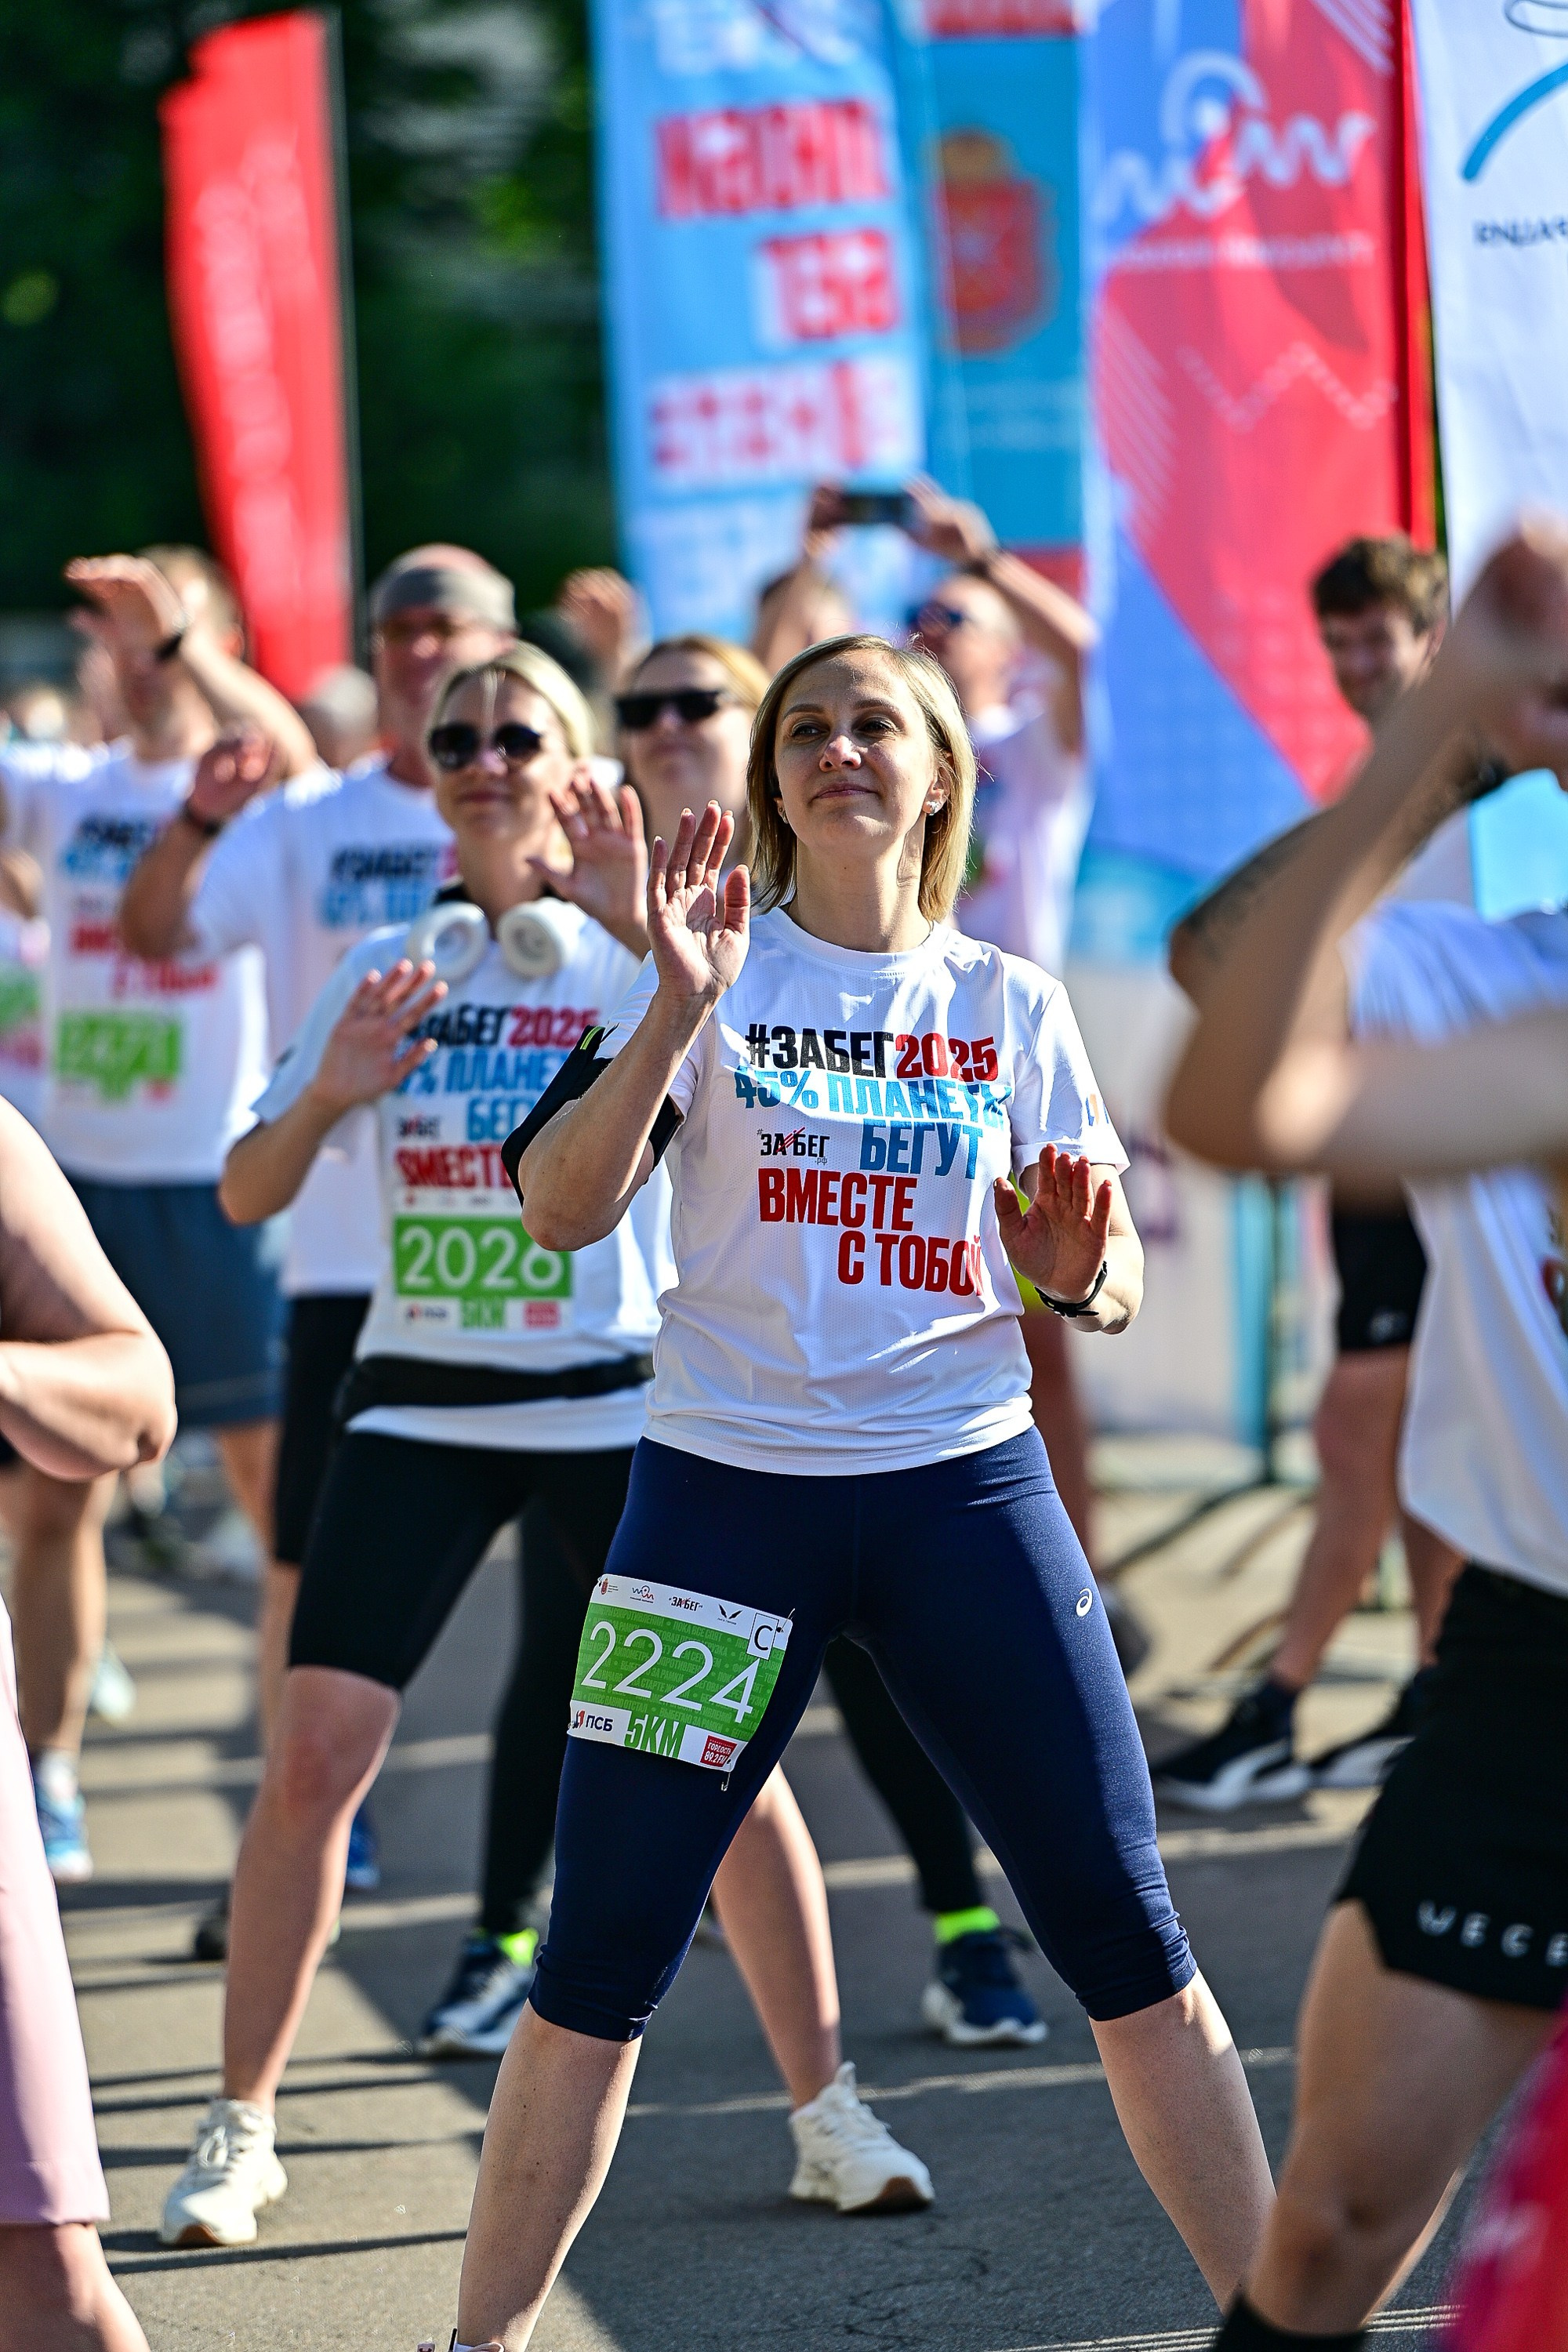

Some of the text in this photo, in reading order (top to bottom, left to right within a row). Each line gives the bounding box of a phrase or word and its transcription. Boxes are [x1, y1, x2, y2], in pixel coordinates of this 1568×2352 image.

[735, 1065, 817, 1109] 45%
[859, 1119, 983, 1180] БЕГУТ
[757, 1167, 918, 1232] ВМЕСТЕ
[400, 1225, 564, 1290] 2026
[838, 1230, 866, 1286] С
[581, 1621, 760, 1724] 2224
[586, 1715, 614, 1731] ПСБ
